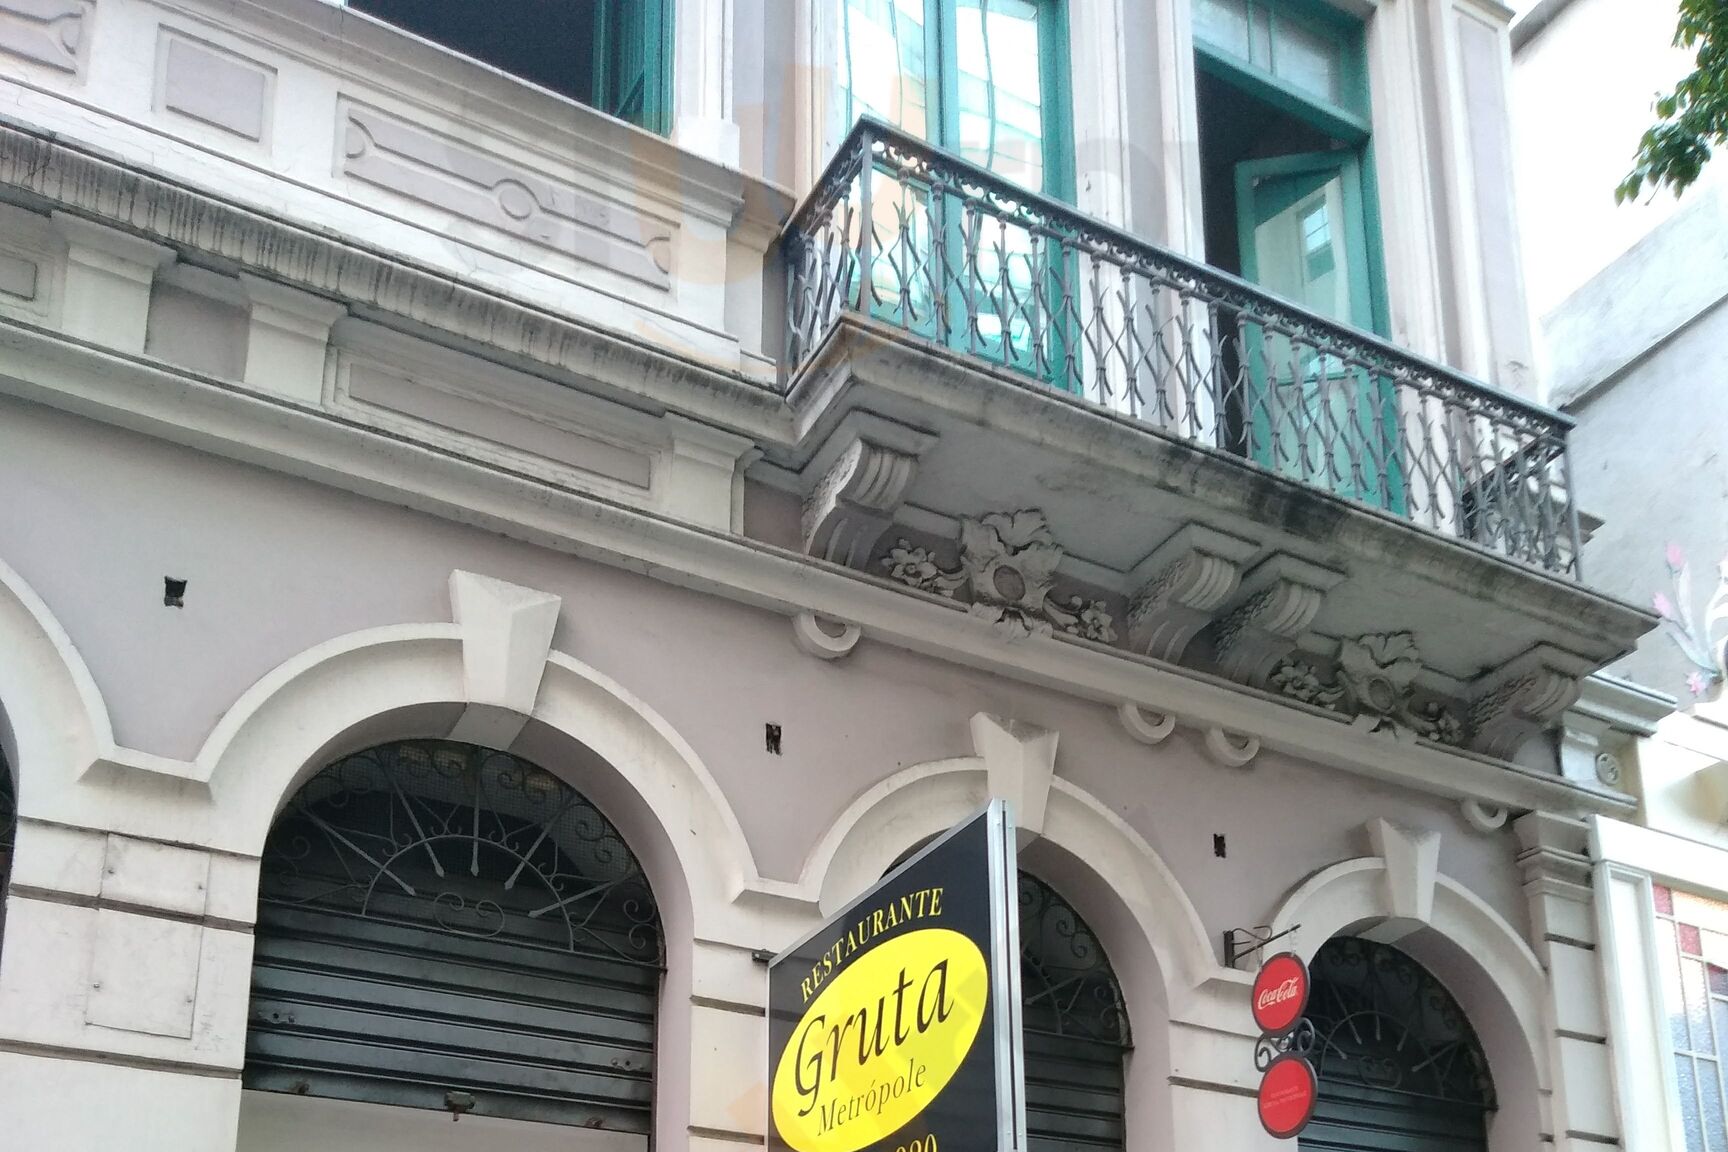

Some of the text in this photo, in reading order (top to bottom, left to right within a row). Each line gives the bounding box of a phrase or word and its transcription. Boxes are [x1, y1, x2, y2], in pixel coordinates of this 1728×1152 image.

[800, 887, 944, 1003] RESTAURANTE
[793, 958, 955, 1117] Gruta
[816, 1057, 927, 1137] Metrópole
